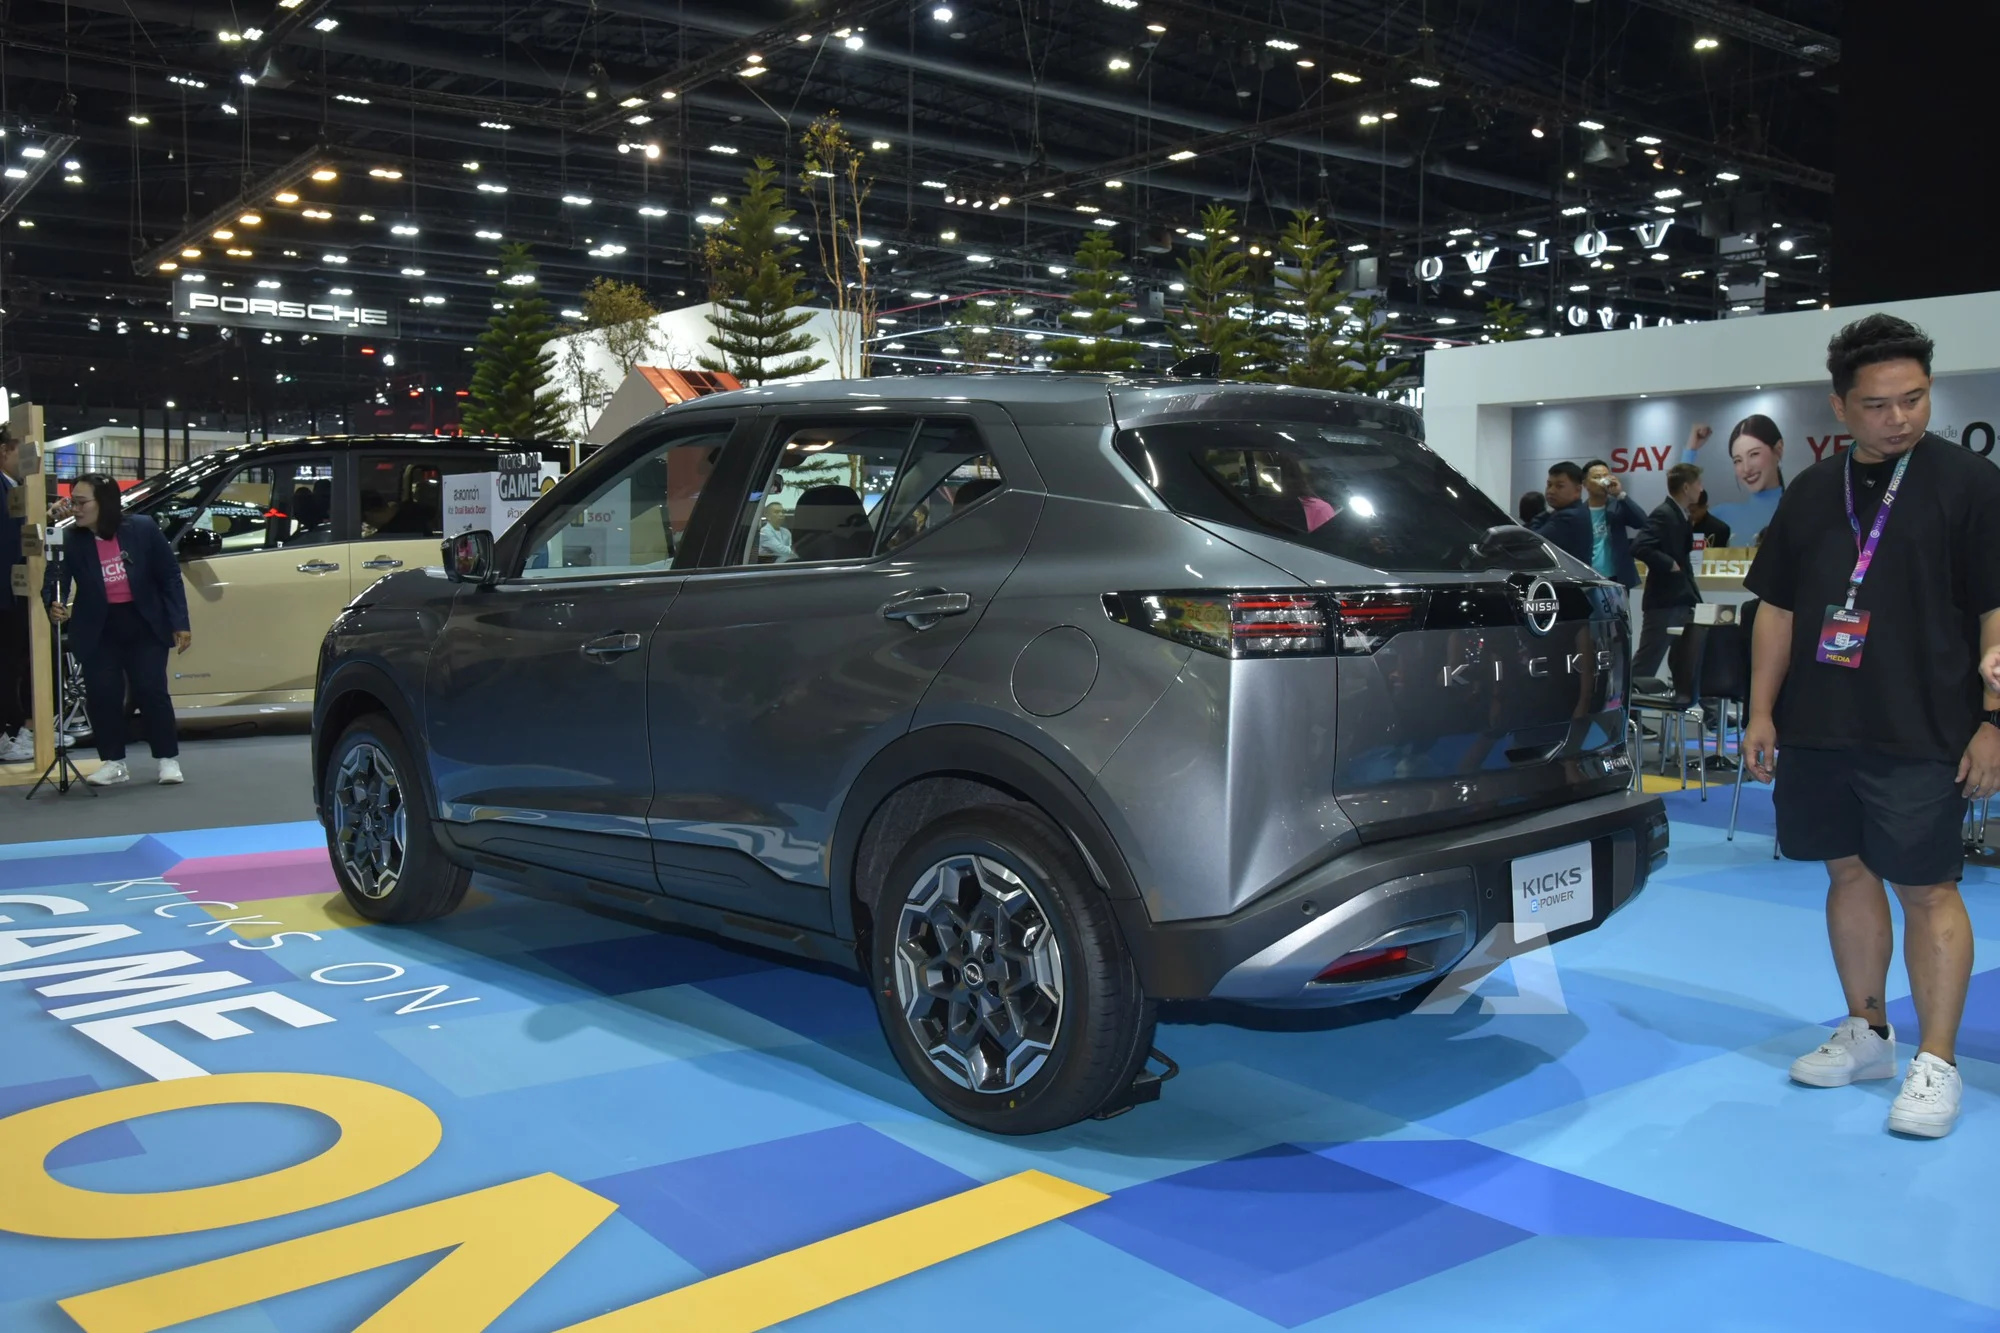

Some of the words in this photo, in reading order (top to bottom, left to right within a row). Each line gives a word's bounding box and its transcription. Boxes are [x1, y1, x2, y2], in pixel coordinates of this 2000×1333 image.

[189, 292, 388, 325] PORSCHE
[1610, 445, 1672, 474] SAY
[1806, 434, 1853, 462] YE
[499, 472, 542, 499] GAME
[475, 505, 486, 514] Door
[101, 562, 126, 577] ICK
[103, 574, 127, 582] POW
[1702, 560, 1752, 576] TEST
[1525, 600, 1559, 612] NISSAN
[1443, 651, 1612, 687] KICKS
[1825, 653, 1851, 663] MEDIA
[1522, 867, 1582, 899] KICKS
[1531, 890, 1574, 913] e-POWER
[93, 876, 322, 951] KICKS
